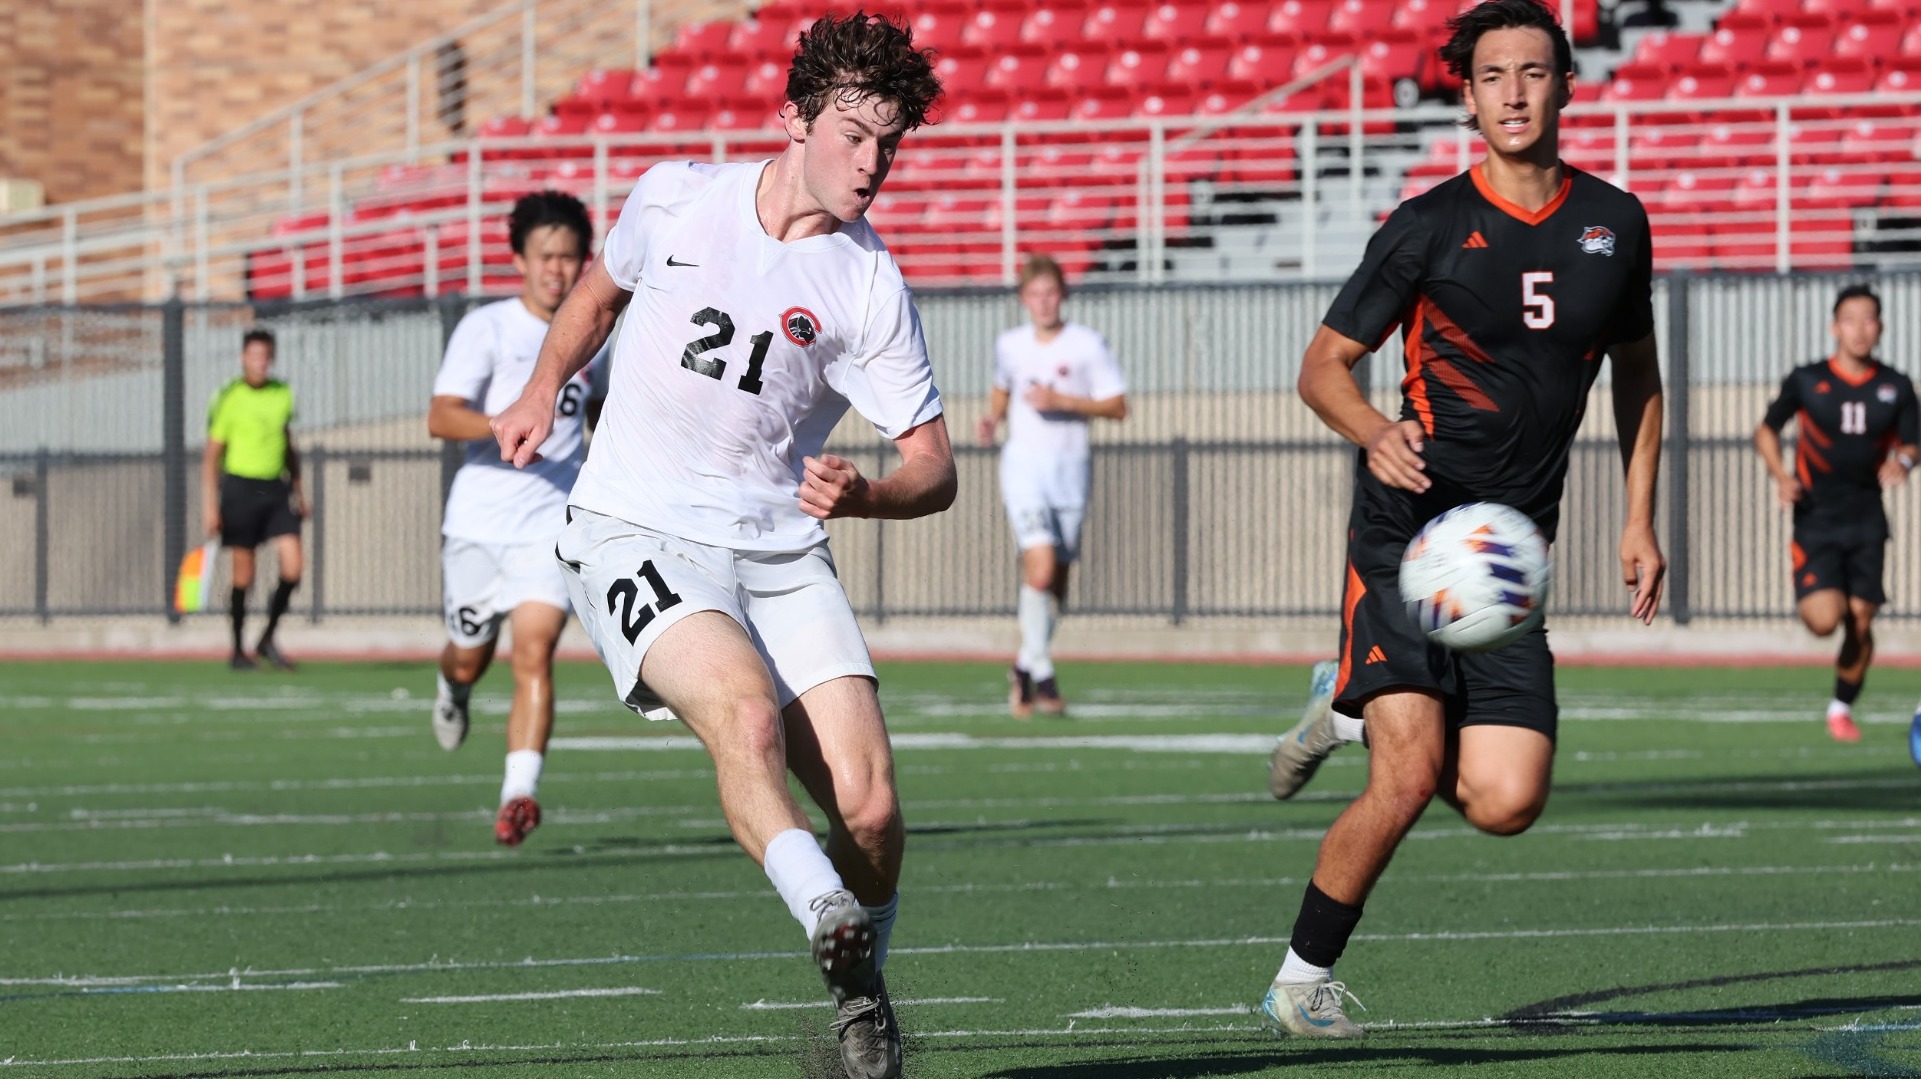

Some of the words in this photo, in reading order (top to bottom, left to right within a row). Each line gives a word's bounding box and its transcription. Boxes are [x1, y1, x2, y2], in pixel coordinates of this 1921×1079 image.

[1522, 271, 1555, 330] 5
[681, 306, 774, 396] 21
[1841, 401, 1866, 435] 11
[607, 559, 683, 647] 21
